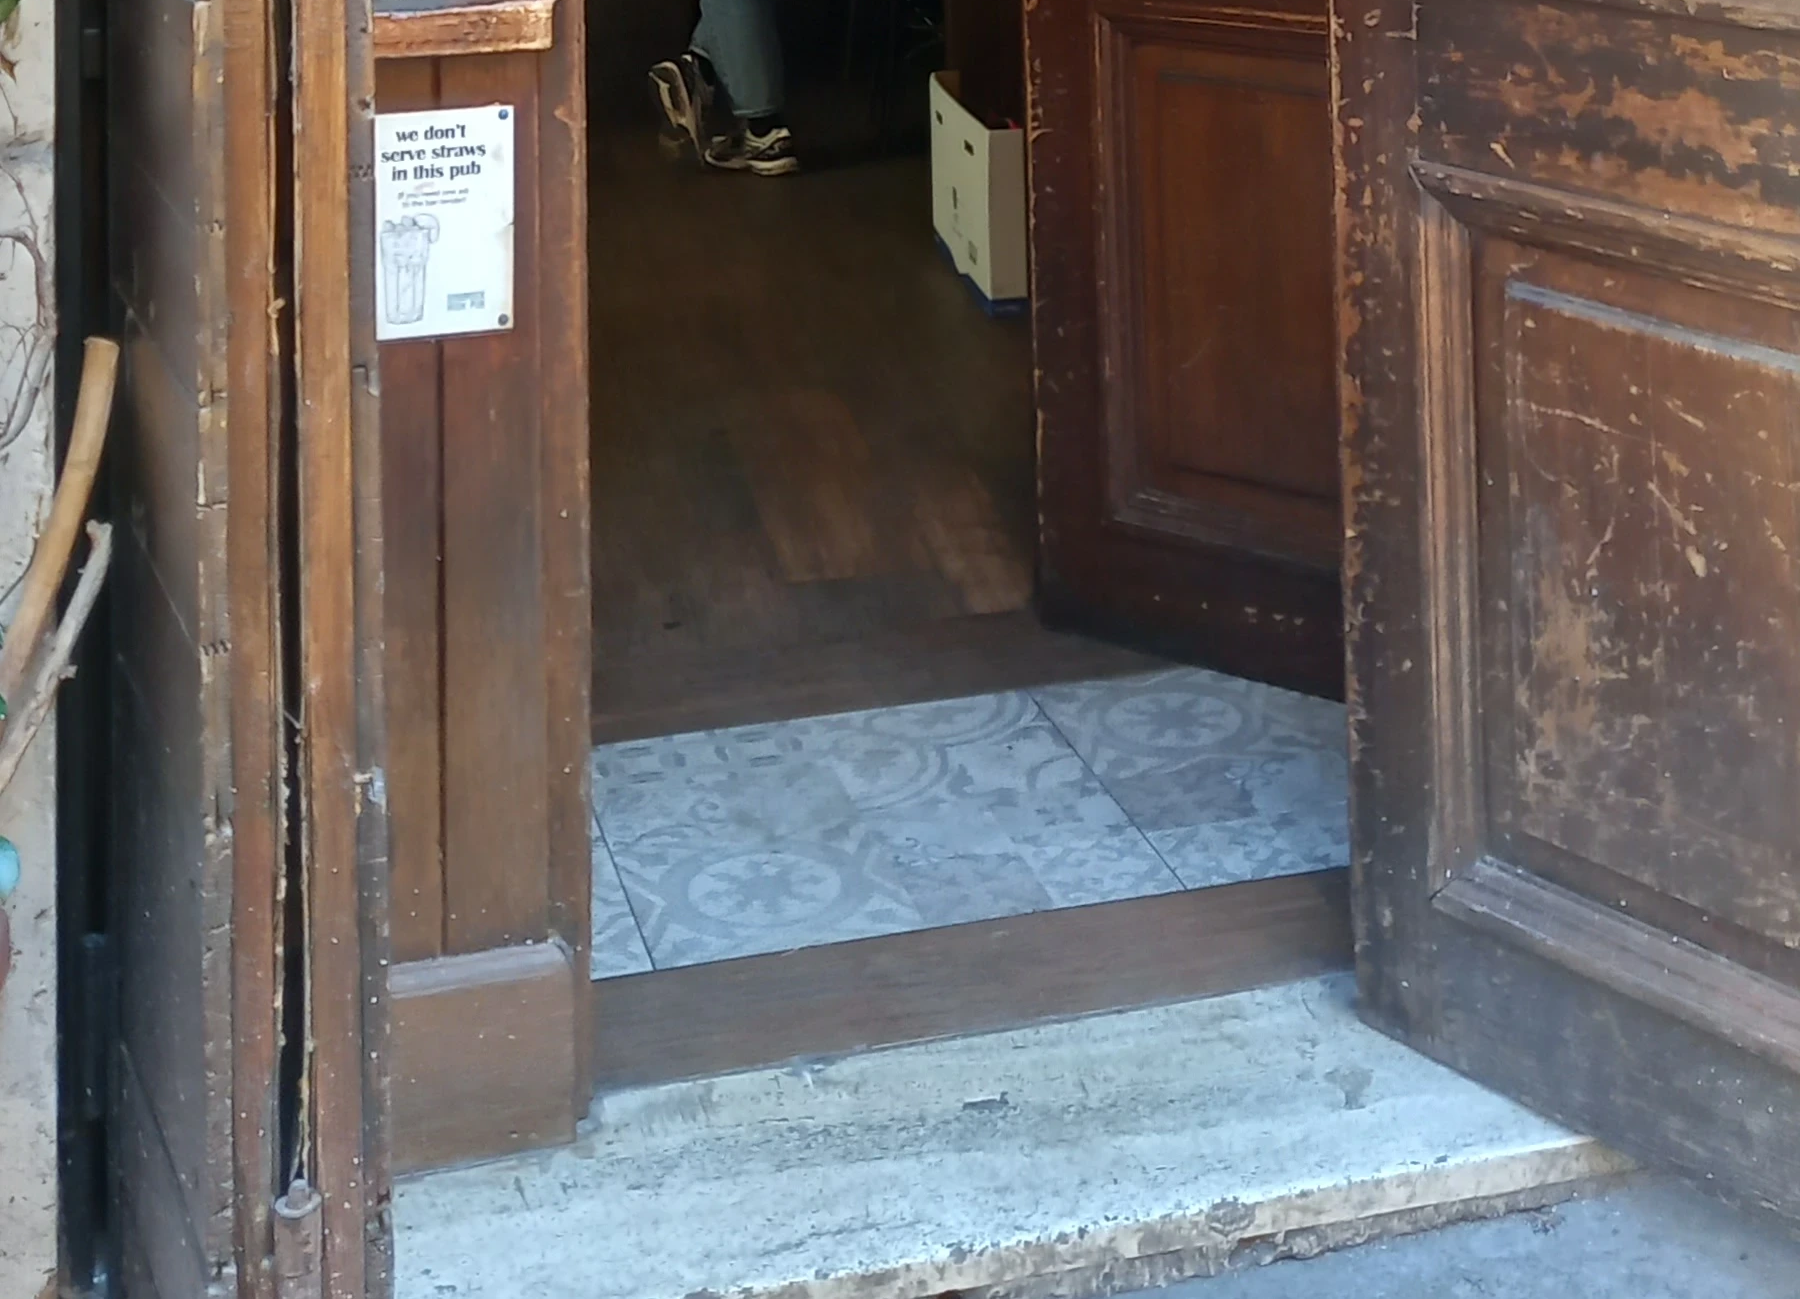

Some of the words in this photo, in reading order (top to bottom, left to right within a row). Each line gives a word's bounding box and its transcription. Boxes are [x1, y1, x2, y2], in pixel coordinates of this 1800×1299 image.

[396, 130, 418, 142] we
[424, 124, 466, 140] don't
[381, 149, 426, 163] serve
[431, 144, 486, 159] straws
[392, 166, 407, 181] in
[413, 164, 444, 179] this
[450, 161, 481, 180] pub
